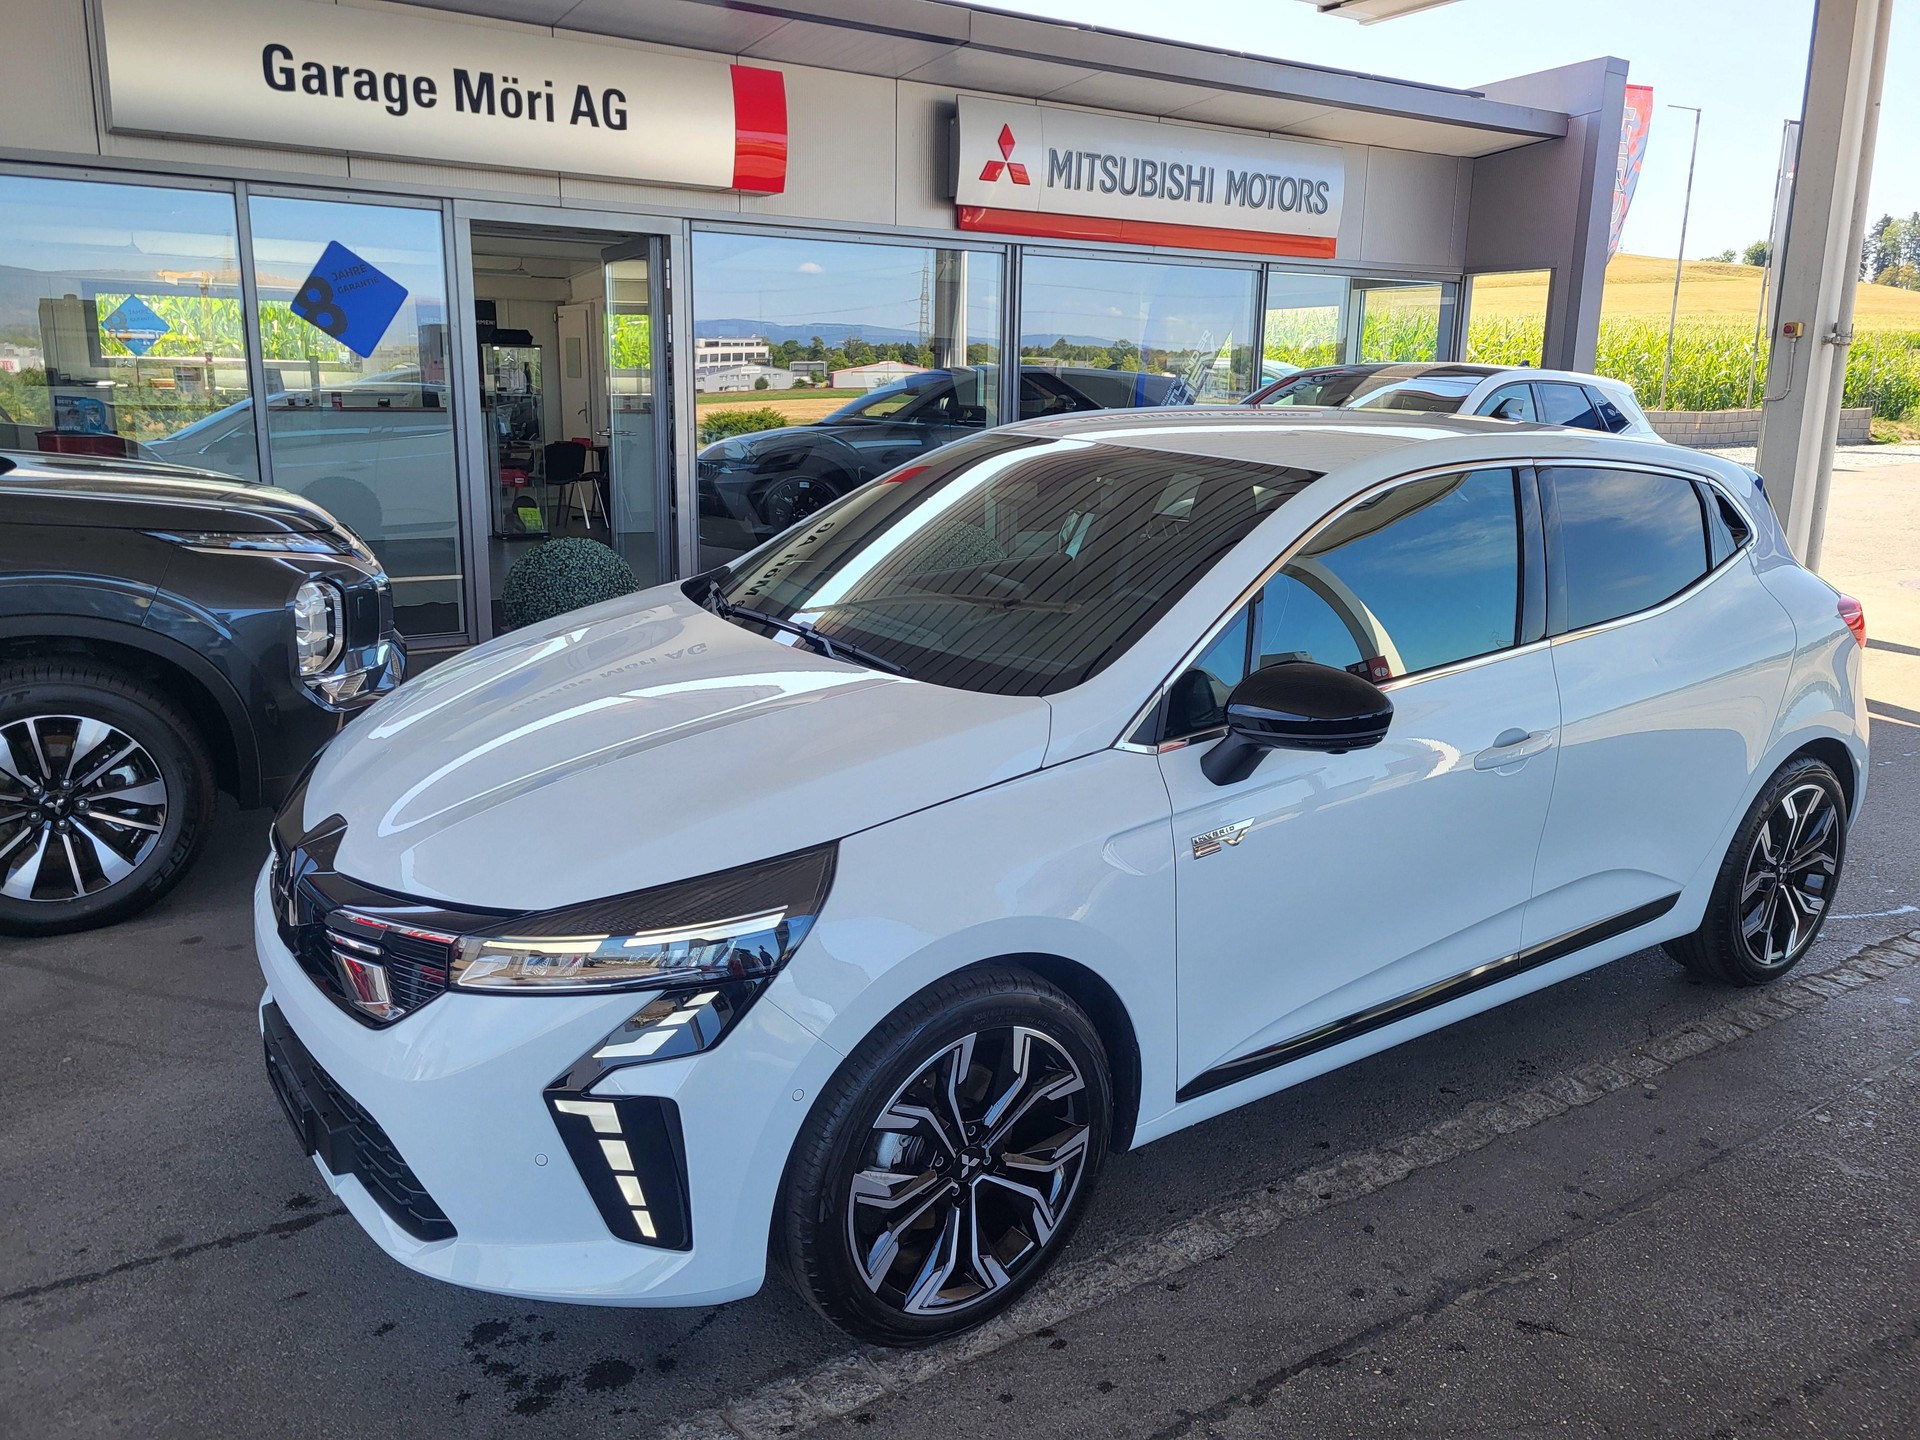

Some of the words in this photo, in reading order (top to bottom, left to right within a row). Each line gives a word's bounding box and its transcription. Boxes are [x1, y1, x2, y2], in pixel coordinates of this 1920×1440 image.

[262, 43, 437, 116] Garage
[453, 68, 555, 122] Möri
[570, 84, 628, 130] AG
[1047, 148, 1214, 204] MITSUBISHI
[1224, 169, 1329, 215] MOTORS
[331, 264, 368, 282] JAHRE
[337, 276, 380, 295] GARANTIE
[295, 276, 348, 338] 8
